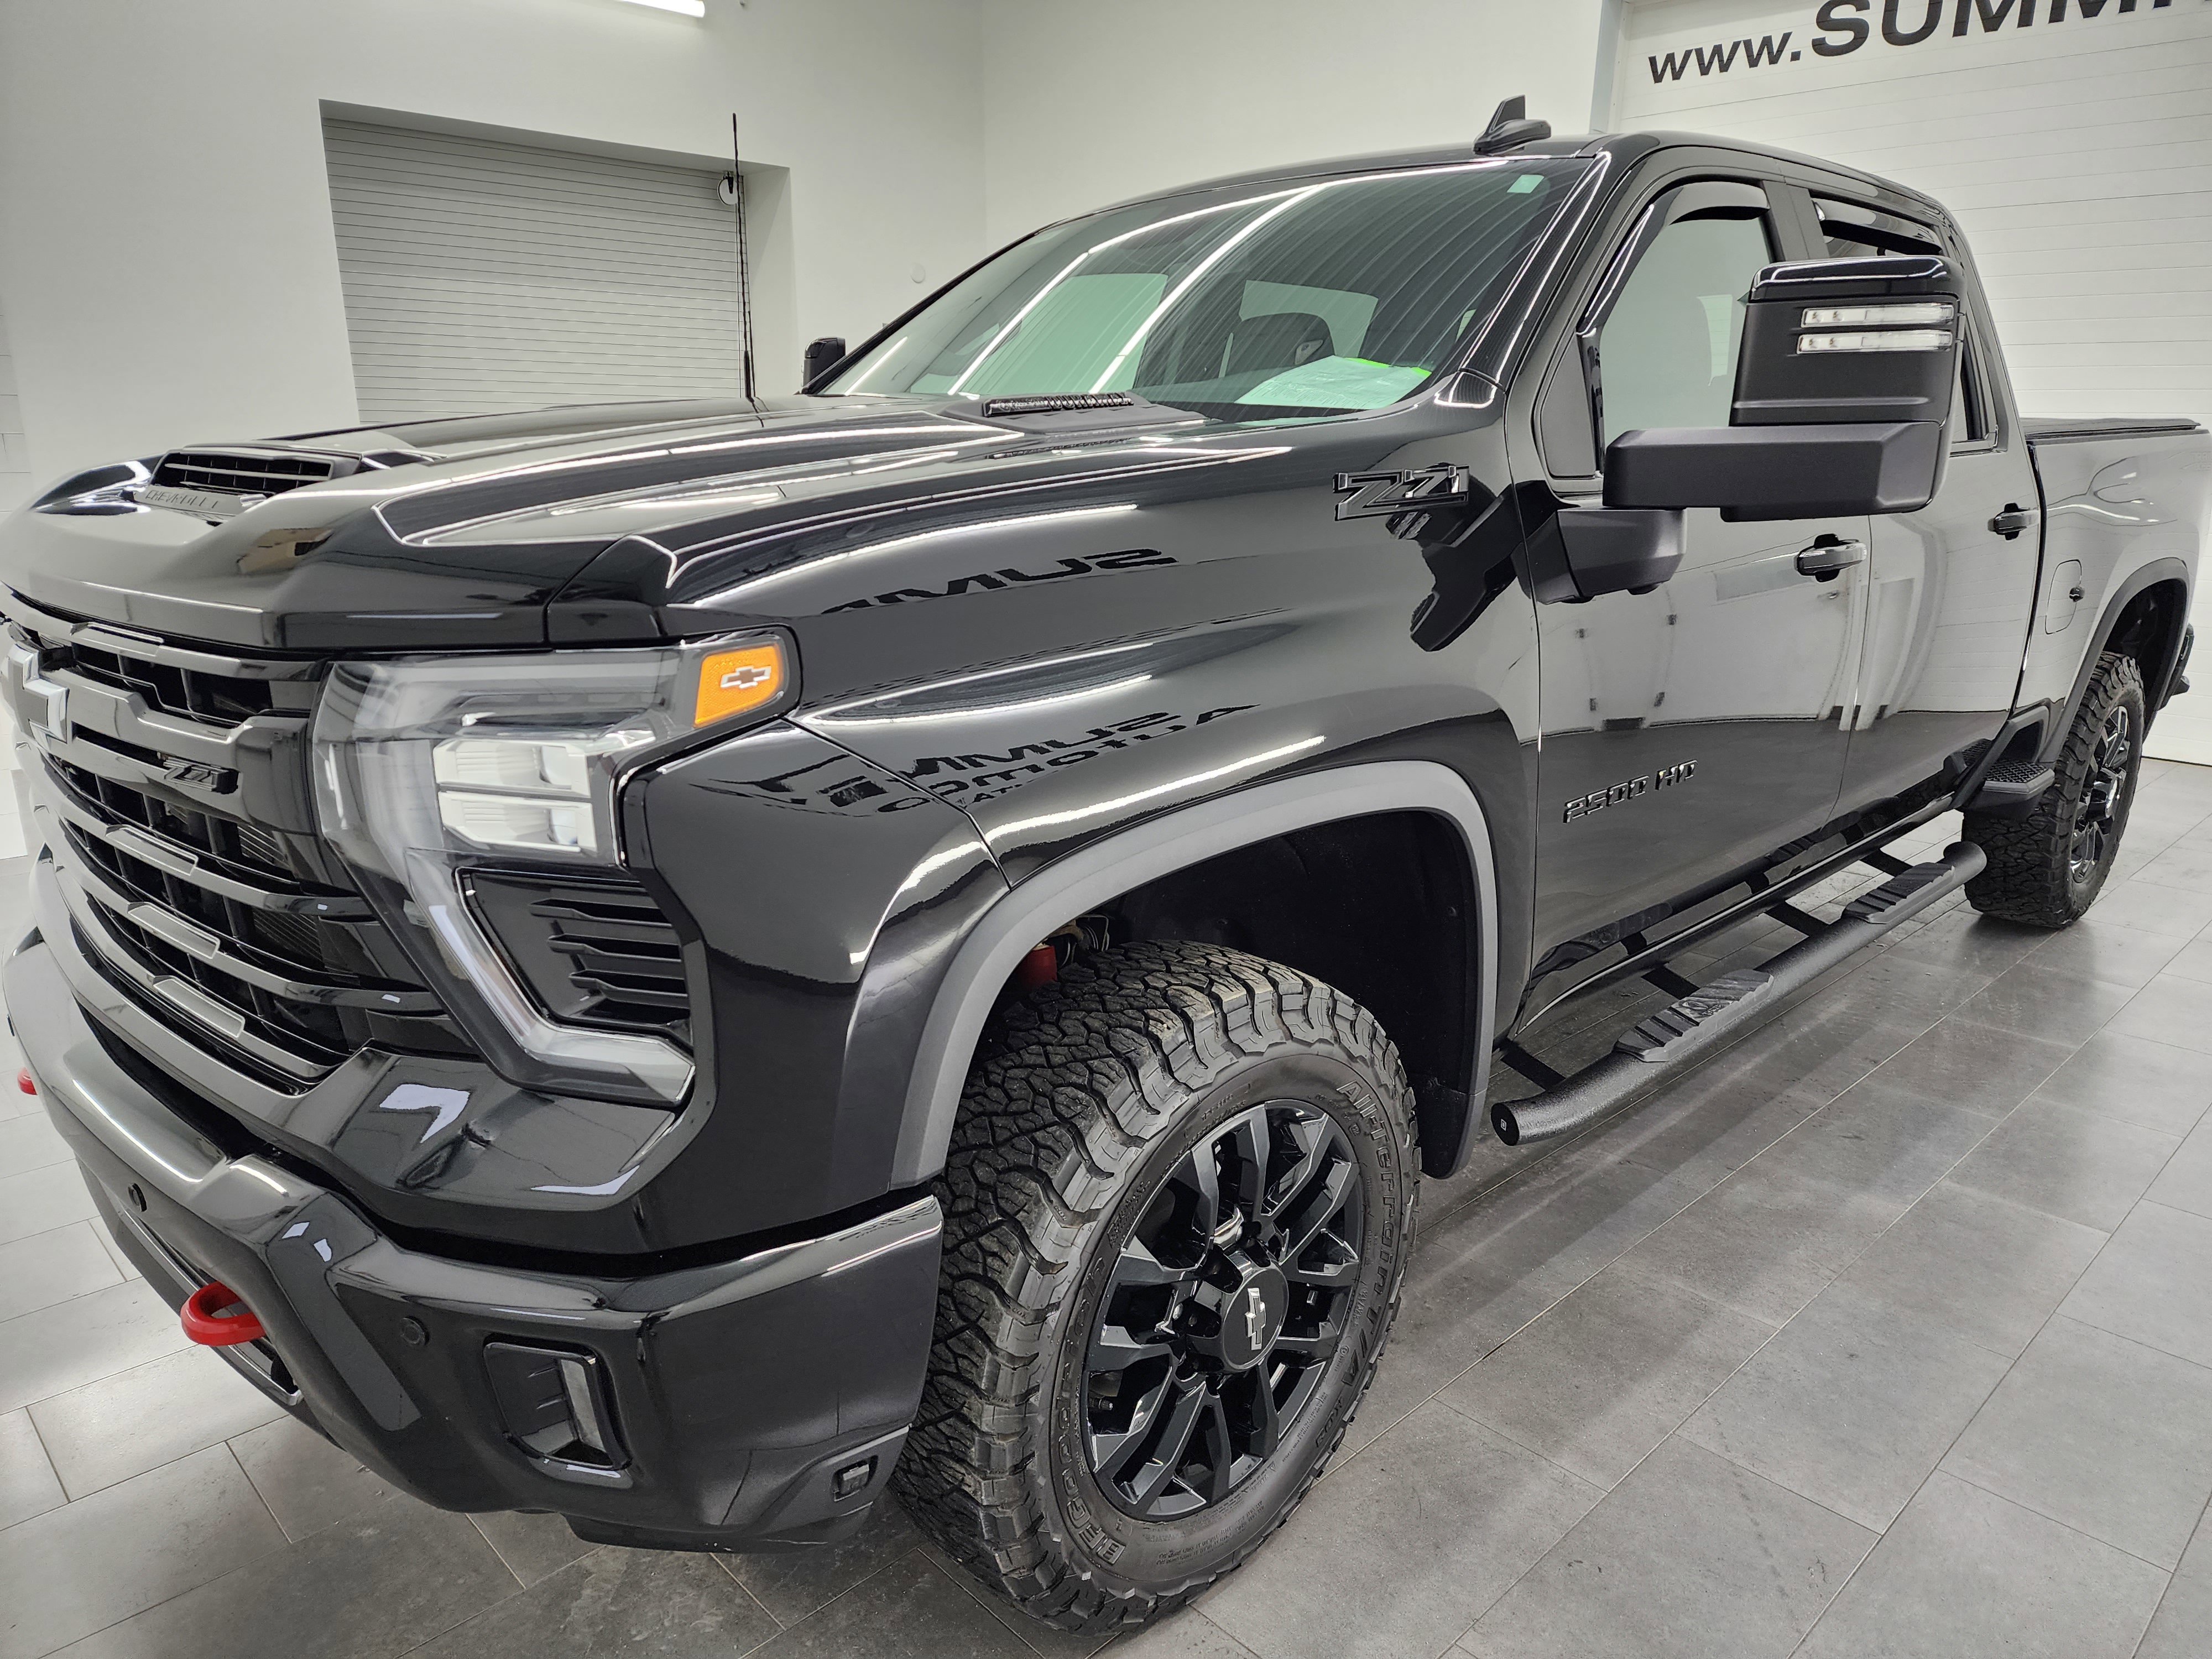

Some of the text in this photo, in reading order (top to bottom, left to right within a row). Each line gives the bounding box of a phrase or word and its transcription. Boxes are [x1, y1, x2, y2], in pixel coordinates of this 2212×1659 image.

[1647, 0, 2172, 84] www.SUM
[1332, 465, 1470, 521] Z71
[163, 757, 229, 792] Z71
[1563, 759, 1698, 823] 2500 HD
[1336, 1079, 1396, 1296] All-Terrain
